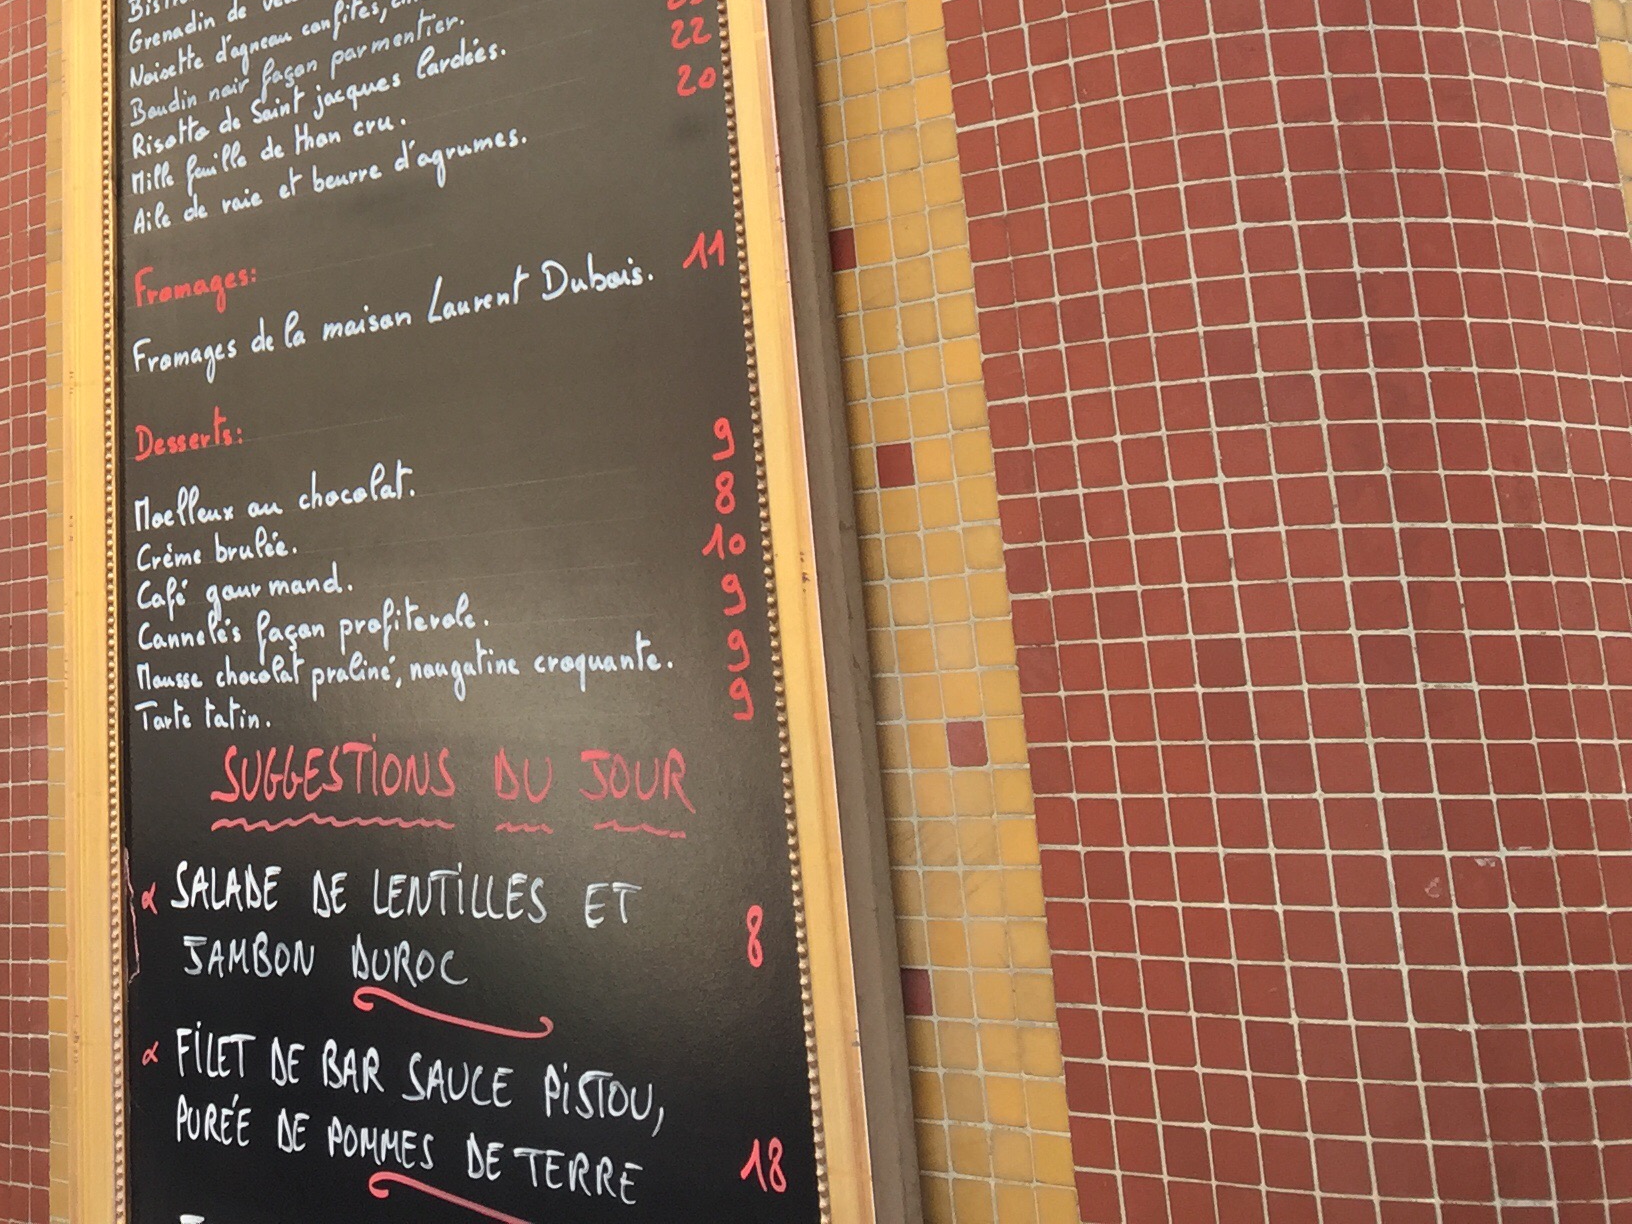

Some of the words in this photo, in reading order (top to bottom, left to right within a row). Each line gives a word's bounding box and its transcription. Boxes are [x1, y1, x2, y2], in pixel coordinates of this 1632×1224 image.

[129, 9, 215, 54] Grenadin
[671, 16, 711, 50] 22
[130, 43, 204, 88] Noisette
[677, 64, 716, 97] 20
[130, 86, 197, 127] Boudin
[209, 78, 249, 101] noir
[219, 105, 241, 134] de
[250, 85, 305, 124] Saint
[131, 161, 174, 195] Mille
[186, 140, 246, 197] feuille
[260, 135, 285, 161] de
[133, 201, 171, 234] Aile
[183, 193, 208, 222] de
[221, 188, 263, 214] raie
[278, 166, 303, 199] et
[312, 164, 383, 193] beurre
[682, 229, 726, 270] 11
[134, 265, 257, 313] Fromages:
[131, 339, 238, 384] Fromages
[251, 317, 275, 353] de
[283, 310, 307, 349] la
[322, 304, 412, 341] maison
[427, 263, 530, 325] Laurent
[134, 405, 243, 461] Desserts:
[712, 417, 735, 461] 9
[134, 485, 234, 532] Moelleux
[247, 501, 283, 518] au
[299, 458, 415, 510] chocolat.
[715, 470, 735, 514] 8
[701, 523, 746, 560] 10
[720, 573, 747, 617] 9
[137, 662, 203, 690] Mousse
[216, 651, 304, 687] chocolat
[409, 638, 519, 701] nougatine
[727, 628, 750, 672] 9
[135, 698, 191, 731] Tarte
[729, 677, 754, 721] 9
[210, 734, 456, 802] SUGGESTIONS
[494, 747, 552, 803] DU
[578, 747, 696, 813] JOUR
[170, 861, 282, 912] SALADE
[312, 870, 348, 918] DE
[371, 861, 548, 923] LENTILLES
[585, 882, 642, 929] ET
[182, 931, 315, 977] JAMBON
[352, 933, 469, 987] DUROC
[744, 904, 764, 968] 8
[174, 1020, 256, 1080] FILET
[270, 1036, 306, 1089] DE
[321, 1039, 384, 1095] BAR
[401, 1052, 513, 1108] SAUCE
[175, 1094, 251, 1147] PURÉE
[277, 1100, 308, 1153] DE
[327, 1115, 434, 1171] POMMES
[466, 1133, 506, 1182] DE
[514, 1147, 643, 1206] TERRE
[740, 1138, 788, 1194] 18
